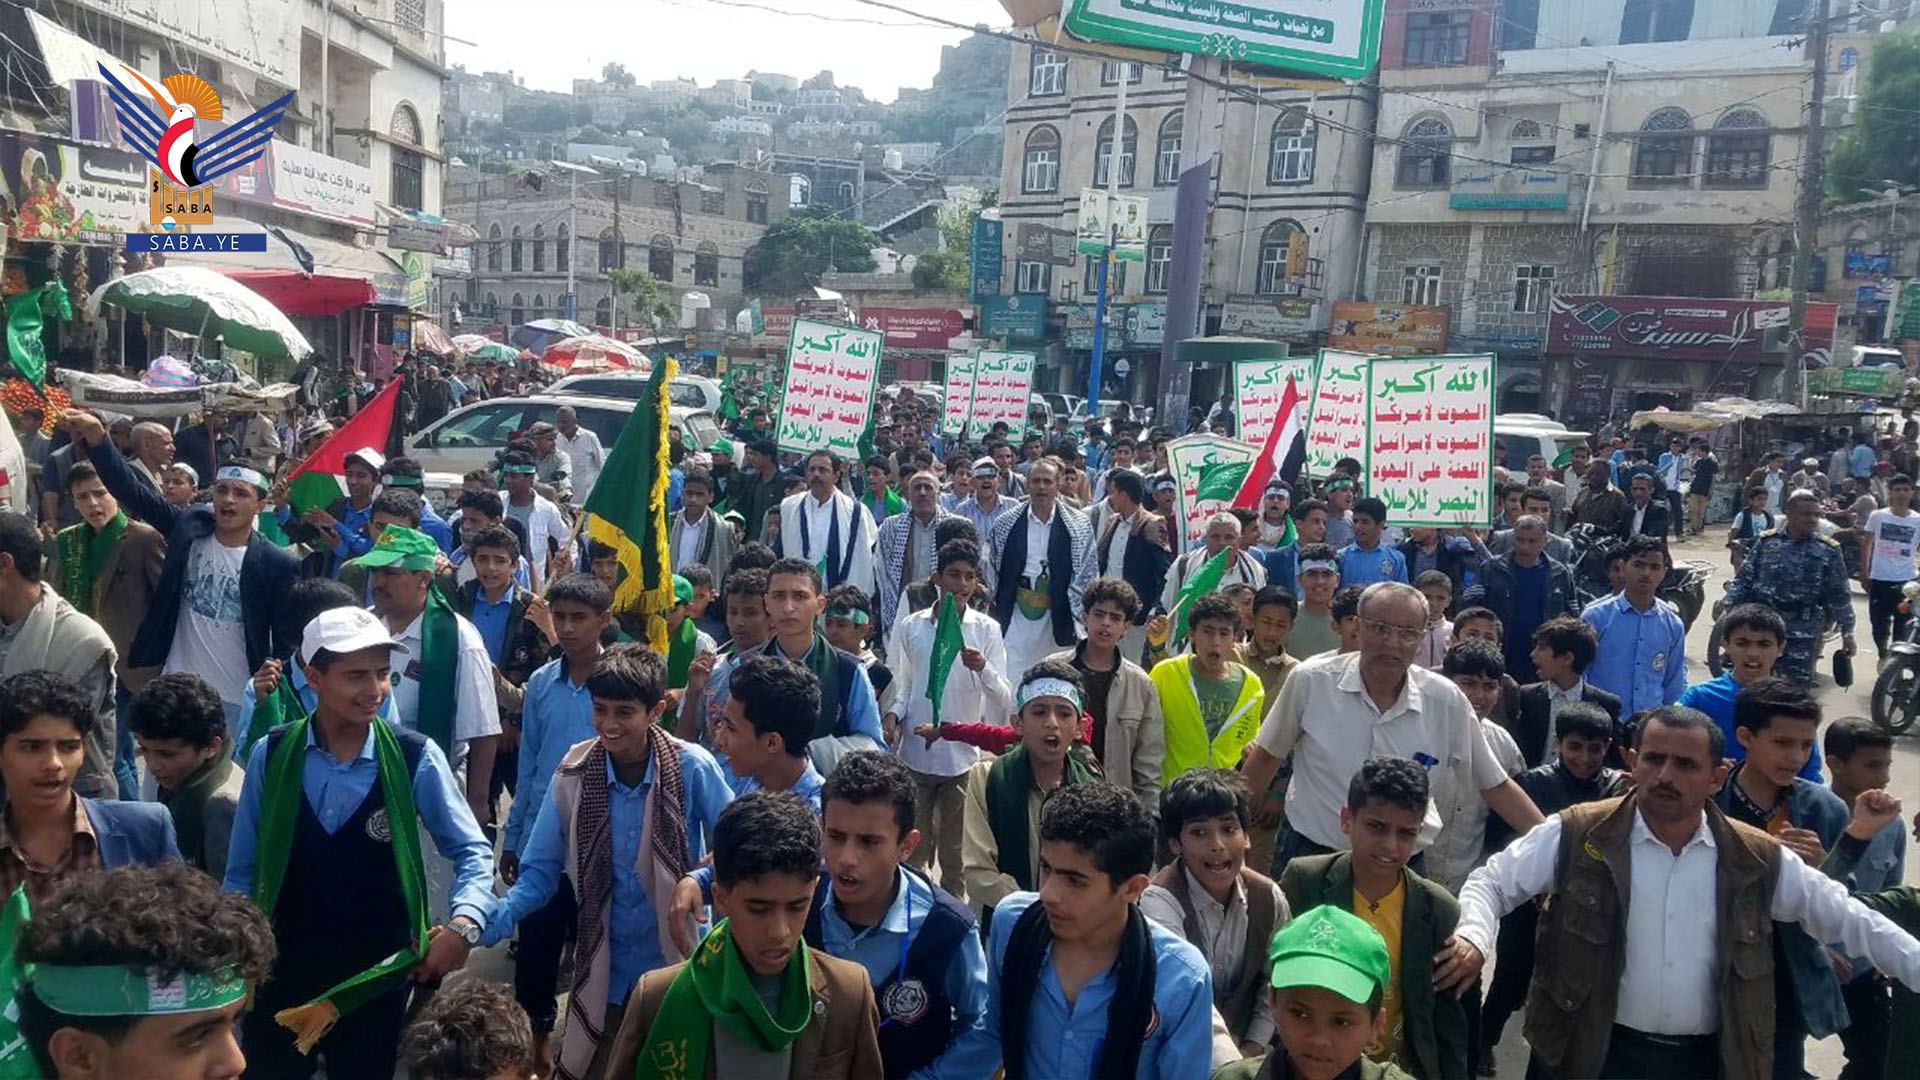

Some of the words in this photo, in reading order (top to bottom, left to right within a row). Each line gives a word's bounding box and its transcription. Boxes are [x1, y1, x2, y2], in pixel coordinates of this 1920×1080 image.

[1222, 7, 1251, 24] الصحة
[1253, 12, 1281, 29] مكتب
[795, 329, 846, 354] أكبر
[846, 336, 877, 357] الله
[837, 366, 872, 381] الموت
[1012, 358, 1033, 373] الله
[1324, 363, 1368, 385] كبر
[1241, 363, 1283, 392] أكبر
[1375, 361, 1443, 401] أكبر
[1445, 363, 1489, 392] الله
[833, 388, 867, 403] الموت
[785, 404, 815, 419] اليهود
[817, 407, 834, 421] على
[838, 408, 865, 425] اللعنة
[1437, 403, 1487, 424] الموت
[1310, 428, 1341, 446] اليهود
[1344, 435, 1362, 449] على
[1436, 432, 1486, 453] الموت
[1373, 461, 1413, 483] اليهود
[1418, 461, 1441, 483] على
[1447, 459, 1485, 480] اللعنة
[1433, 485, 1485, 516] النصر
